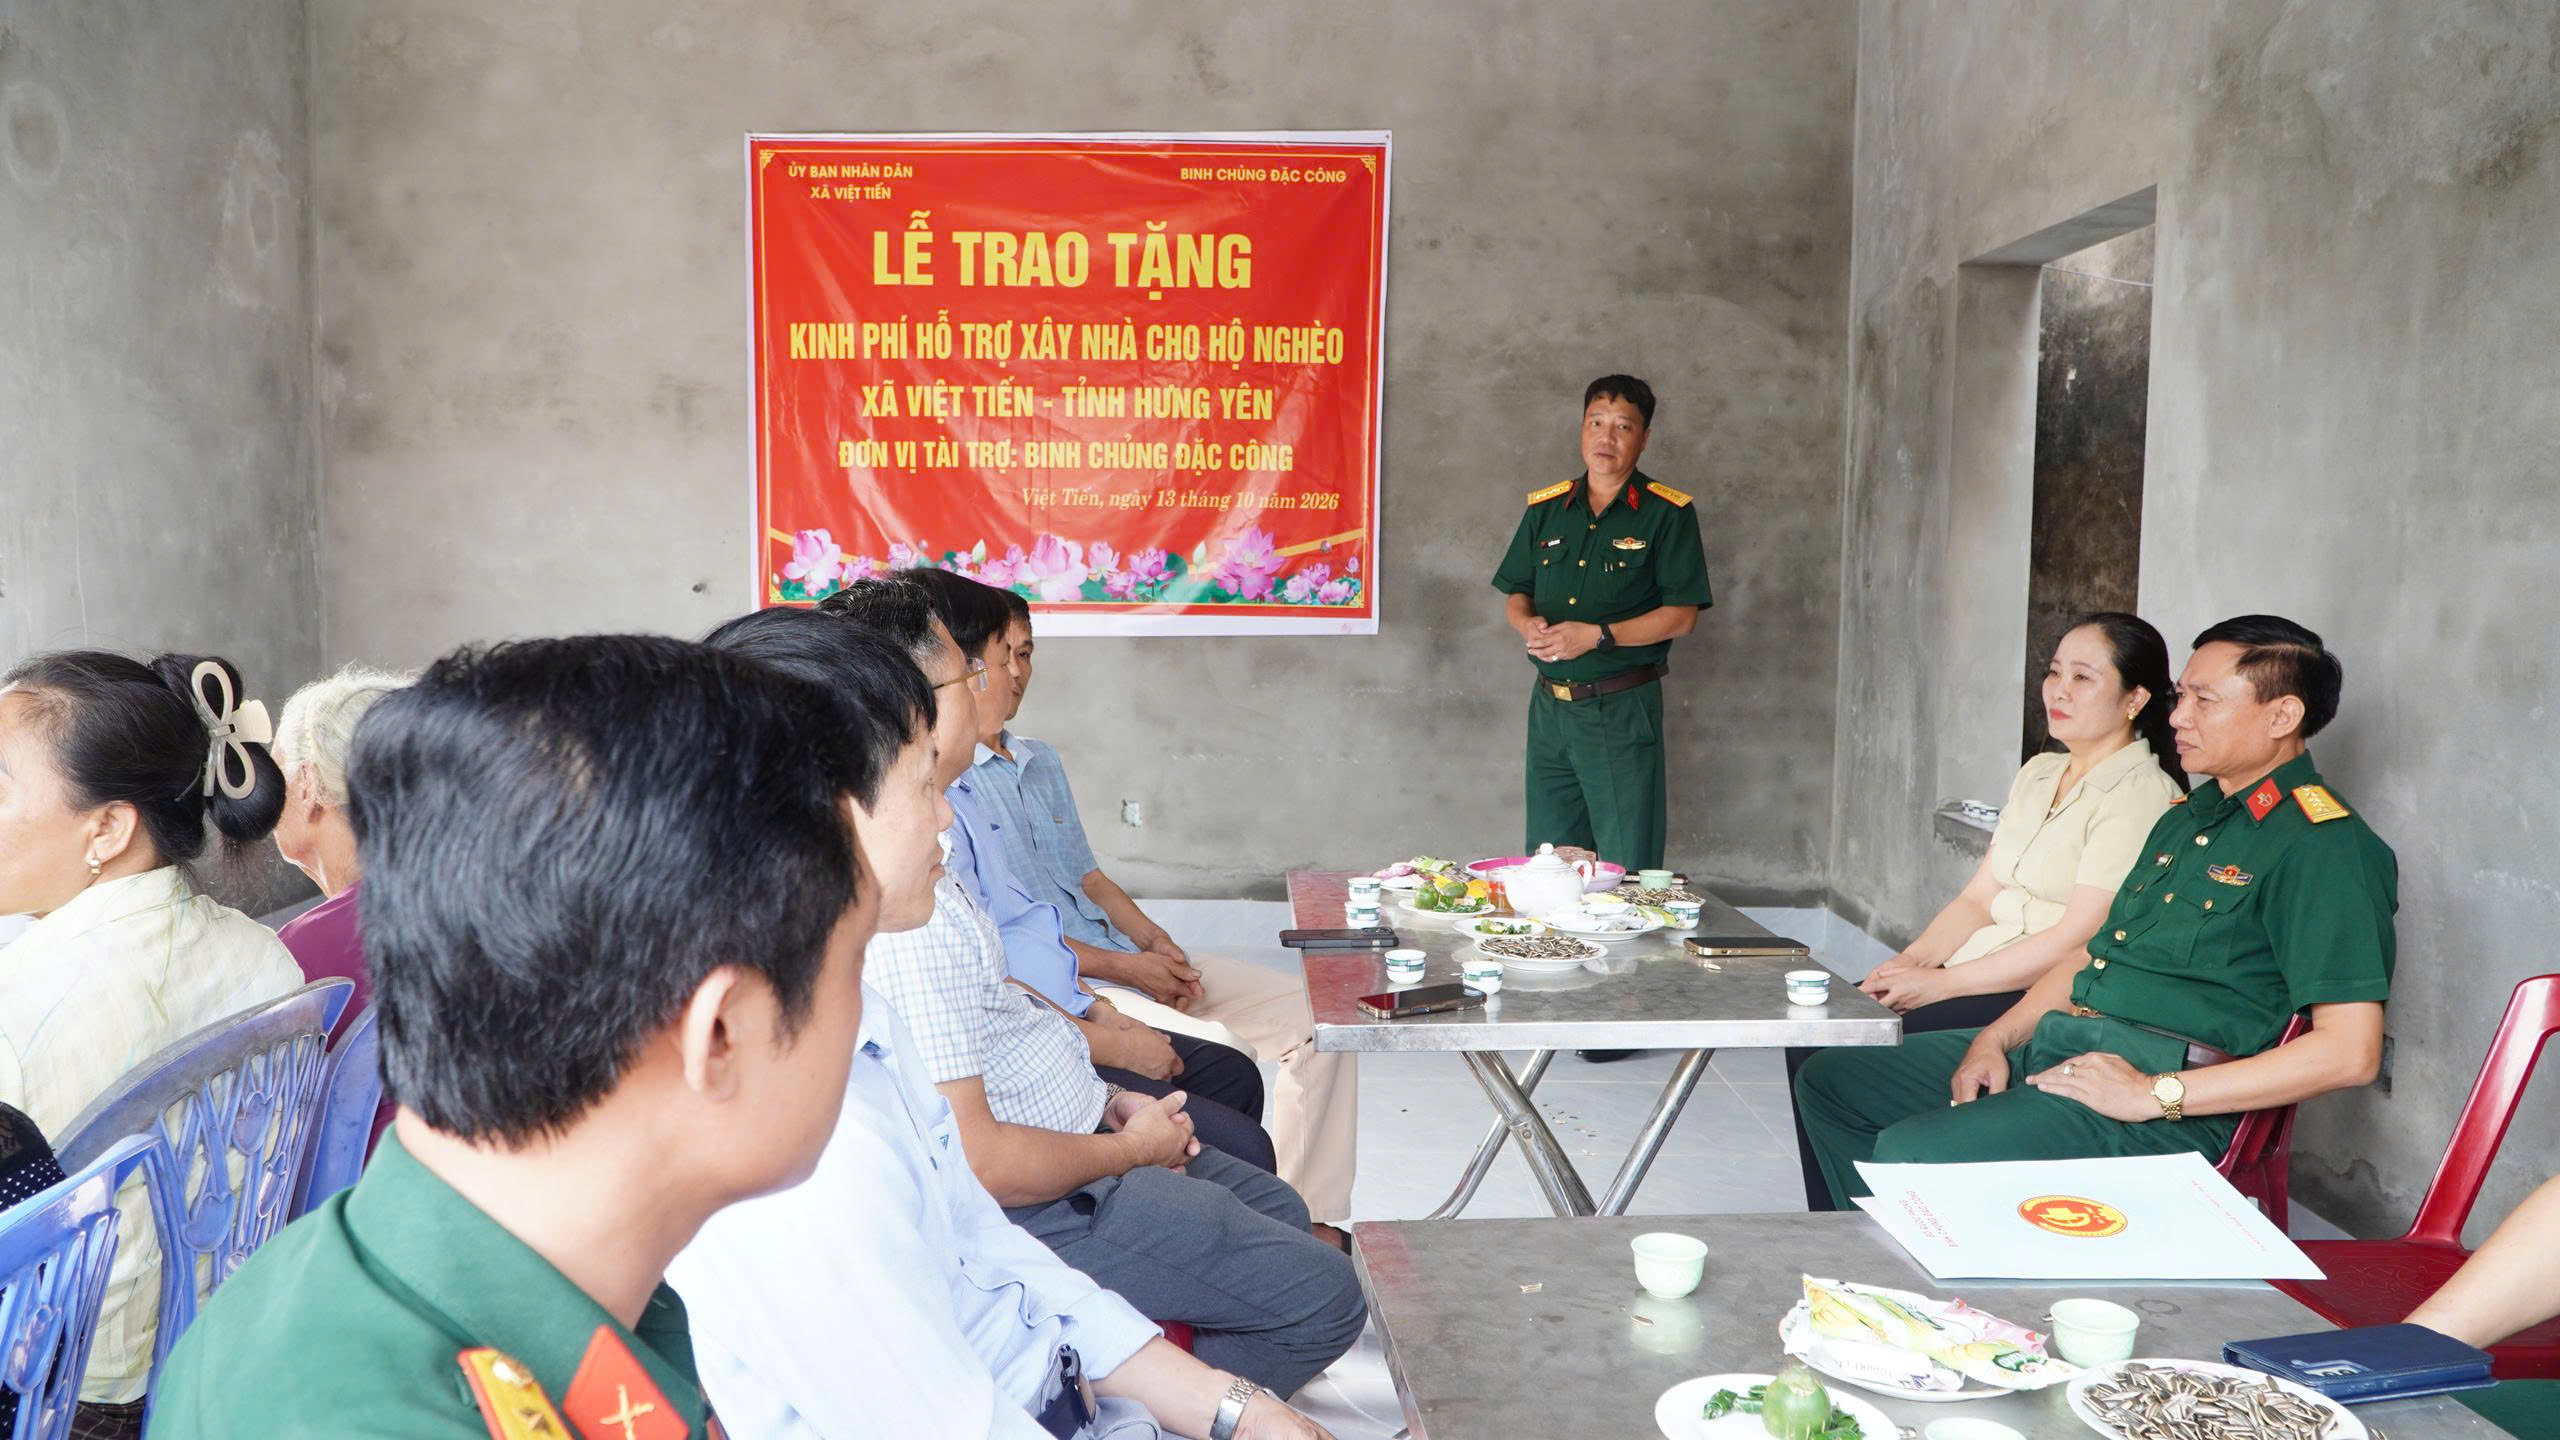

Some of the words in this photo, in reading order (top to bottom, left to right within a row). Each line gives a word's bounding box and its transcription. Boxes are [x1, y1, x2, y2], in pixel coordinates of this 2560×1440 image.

[788, 161, 806, 178] ỦY
[810, 165, 838, 178] BAN
[841, 162, 880, 178] NHÂN
[883, 162, 913, 178] DÂN
[1180, 167, 1213, 181] BINH
[1216, 164, 1267, 182] CHỦNG
[1270, 166, 1301, 186] ĐẶC
[1304, 167, 1347, 183] CÔNG
[810, 184, 831, 199] XÃ
[834, 184, 861, 203] VIỆT
[863, 182, 892, 200] TIẾN
[873, 210, 934, 286] LỄ
[952, 231, 1089, 287] TRAO
[1107, 220, 1252, 300] TẶNG
[790, 322, 856, 360] KINH
[862, 314, 908, 360] PHÍ
[916, 309, 952, 360] HỖ
[960, 319, 1014, 368] TRỢ
[1019, 316, 1074, 361] XÂY
[1081, 316, 1138, 361] NHÀ
[1146, 324, 1201, 362] CHO
[1208, 317, 1246, 370] HỘ
[1253, 319, 1345, 365] NGHÈO
[861, 379, 900, 418] XÃ
[905, 378, 965, 424] VIỆT
[971, 375, 1034, 418] TIẾN
[1061, 375, 1126, 418] TỈNH
[1134, 384, 1211, 419] HƯNG
[1218, 382, 1273, 421] YÊN
[838, 438, 888, 469] ĐƠN
[894, 441, 917, 474] VỊ
[923, 435, 960, 469] TÀI
[965, 438, 1018, 474] TRỢ:
[1024, 441, 1081, 470] BINH
[1087, 432, 1169, 470] CHỦNG
[1175, 437, 1222, 476] ĐẶC
[1229, 438, 1294, 472] CÔNG
[1021, 486, 1057, 511] Việt
[1060, 486, 1105, 510] Tiến,
[1108, 490, 1152, 512] ngày
[1155, 489, 1176, 508] 13
[1179, 489, 1232, 513] tháng
[1235, 490, 1255, 508] 10
[1257, 491, 1297, 510] năm
[1299, 492, 1341, 511] 2026
